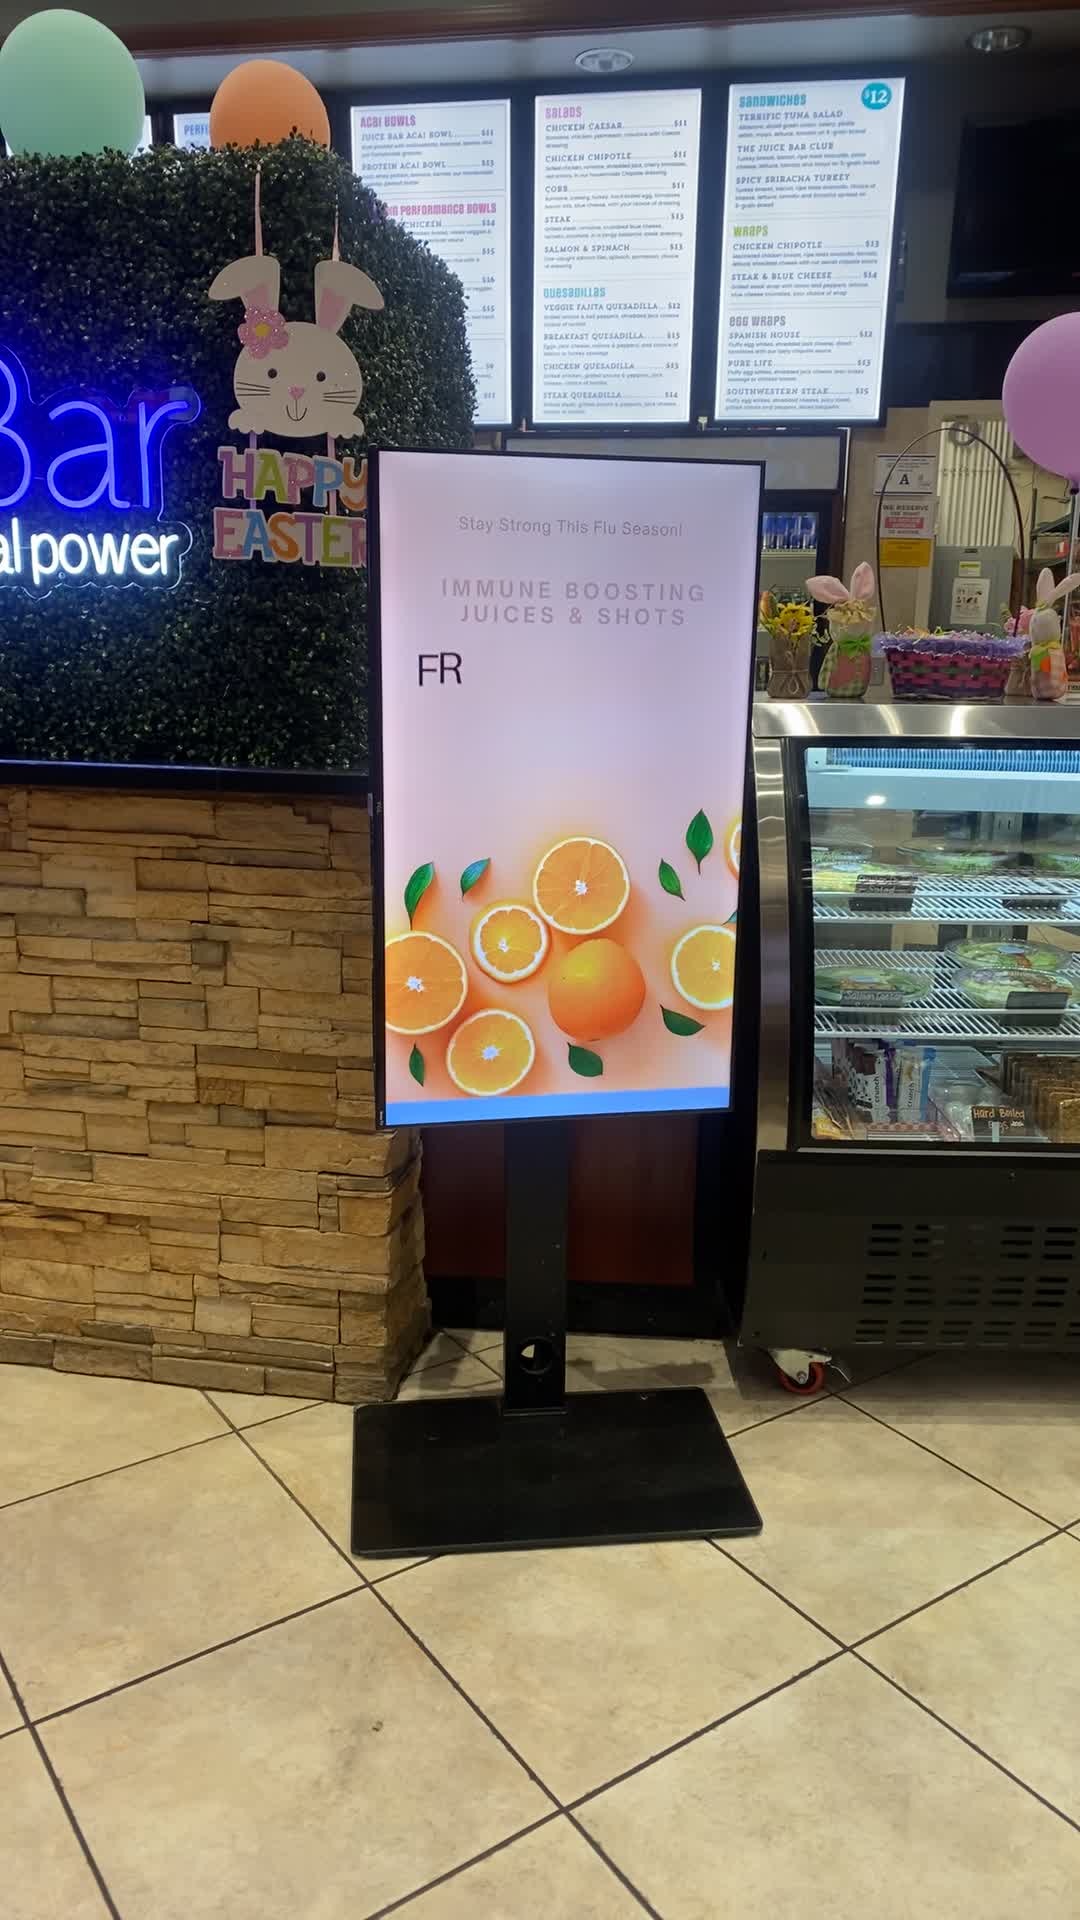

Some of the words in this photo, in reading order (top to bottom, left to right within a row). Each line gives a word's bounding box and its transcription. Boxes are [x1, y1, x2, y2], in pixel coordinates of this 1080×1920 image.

[738, 94, 807, 108] SANDWICHES
[864, 89, 888, 104] $12
[545, 106, 583, 119] SALADS
[738, 112, 781, 121] TERRIFIC
[784, 112, 810, 120] TUNA
[813, 111, 844, 119] SALAD
[384, 115, 416, 128] BOWLS
[545, 123, 585, 132] CHICKEN
[588, 122, 623, 131] CAESAR
[361, 132, 385, 141] JUICE
[387, 132, 403, 140] BAR
[406, 131, 426, 140] ACAI
[429, 130, 453, 139] BOWL
[737, 145, 755, 153] THE
[758, 144, 785, 152] JUICE
[788, 143, 806, 151] BAR
[809, 142, 834, 150] CLUB
[545, 155, 585, 163] CHICKEN
[588, 153, 632, 161] CHIPOTLE
[362, 162, 398, 171] PROTEIN
[400, 162, 420, 170] ACAI
[422, 161, 447, 169] BOWL
[736, 176, 762, 185] SPICY
[764, 175, 811, 184] SRIRACHA
[814, 173, 850, 182] TURKEY
[545, 185, 568, 193] COBB
[400, 203, 465, 216] PERFORMANCE
[467, 202, 497, 214] BOWLS
[544, 216, 571, 224] STEAK
[733, 225, 769, 238] WRAPS
[544, 245, 580, 254] SALMON
[591, 244, 630, 252] SPINACH
[732, 242, 774, 251] CHICKEN
[777, 241, 823, 250] CHIPOTLE
[731, 273, 759, 281] STEAK
[771, 272, 794, 280] BLUE
[797, 271, 832, 280] CHEESE
[543, 287, 606, 299] QUESADILLAS
[544, 303, 575, 311] VEGGIE
[576, 303, 604, 311] FAJITA
[606, 302, 658, 311] QUESADILLA
[729, 315, 749, 327] EGG
[751, 315, 786, 327] WRAPS
[544, 333, 589, 341] BREAKFAST
[591, 332, 644, 340] QUESADILLA
[729, 331, 767, 340] SPANISH
[770, 331, 800, 339] HOUSE
[543, 362, 580, 371] CHICKEN
[583, 362, 635, 371] QUESADILLA
[727, 359, 751, 367] PURE
[754, 359, 773, 367] LIFE
[543, 391, 569, 399] STEAK
[570, 391, 622, 399] QUESADILLA
[727, 387, 798, 396] SOUTHWESTERN
[801, 387, 829, 395] STEAK
[218, 446, 367, 511] HAPPY
[899, 474, 910, 485] A
[458, 515, 494, 534] Stay
[499, 517, 551, 537] Strong
[556, 519, 589, 534] This
[593, 520, 617, 535] Flu
[621, 521, 683, 537] Season!
[213, 507, 366, 567] EASTER
[30, 532, 180, 586] power
[441, 577, 552, 599] IMMUNE
[565, 582, 705, 602] BOOSTING
[460, 604, 554, 624] JUICES
[568, 606, 583, 624] &
[597, 607, 686, 626] SHOTS
[417, 651, 463, 687] FR
[973, 1107, 995, 1119] Hard
